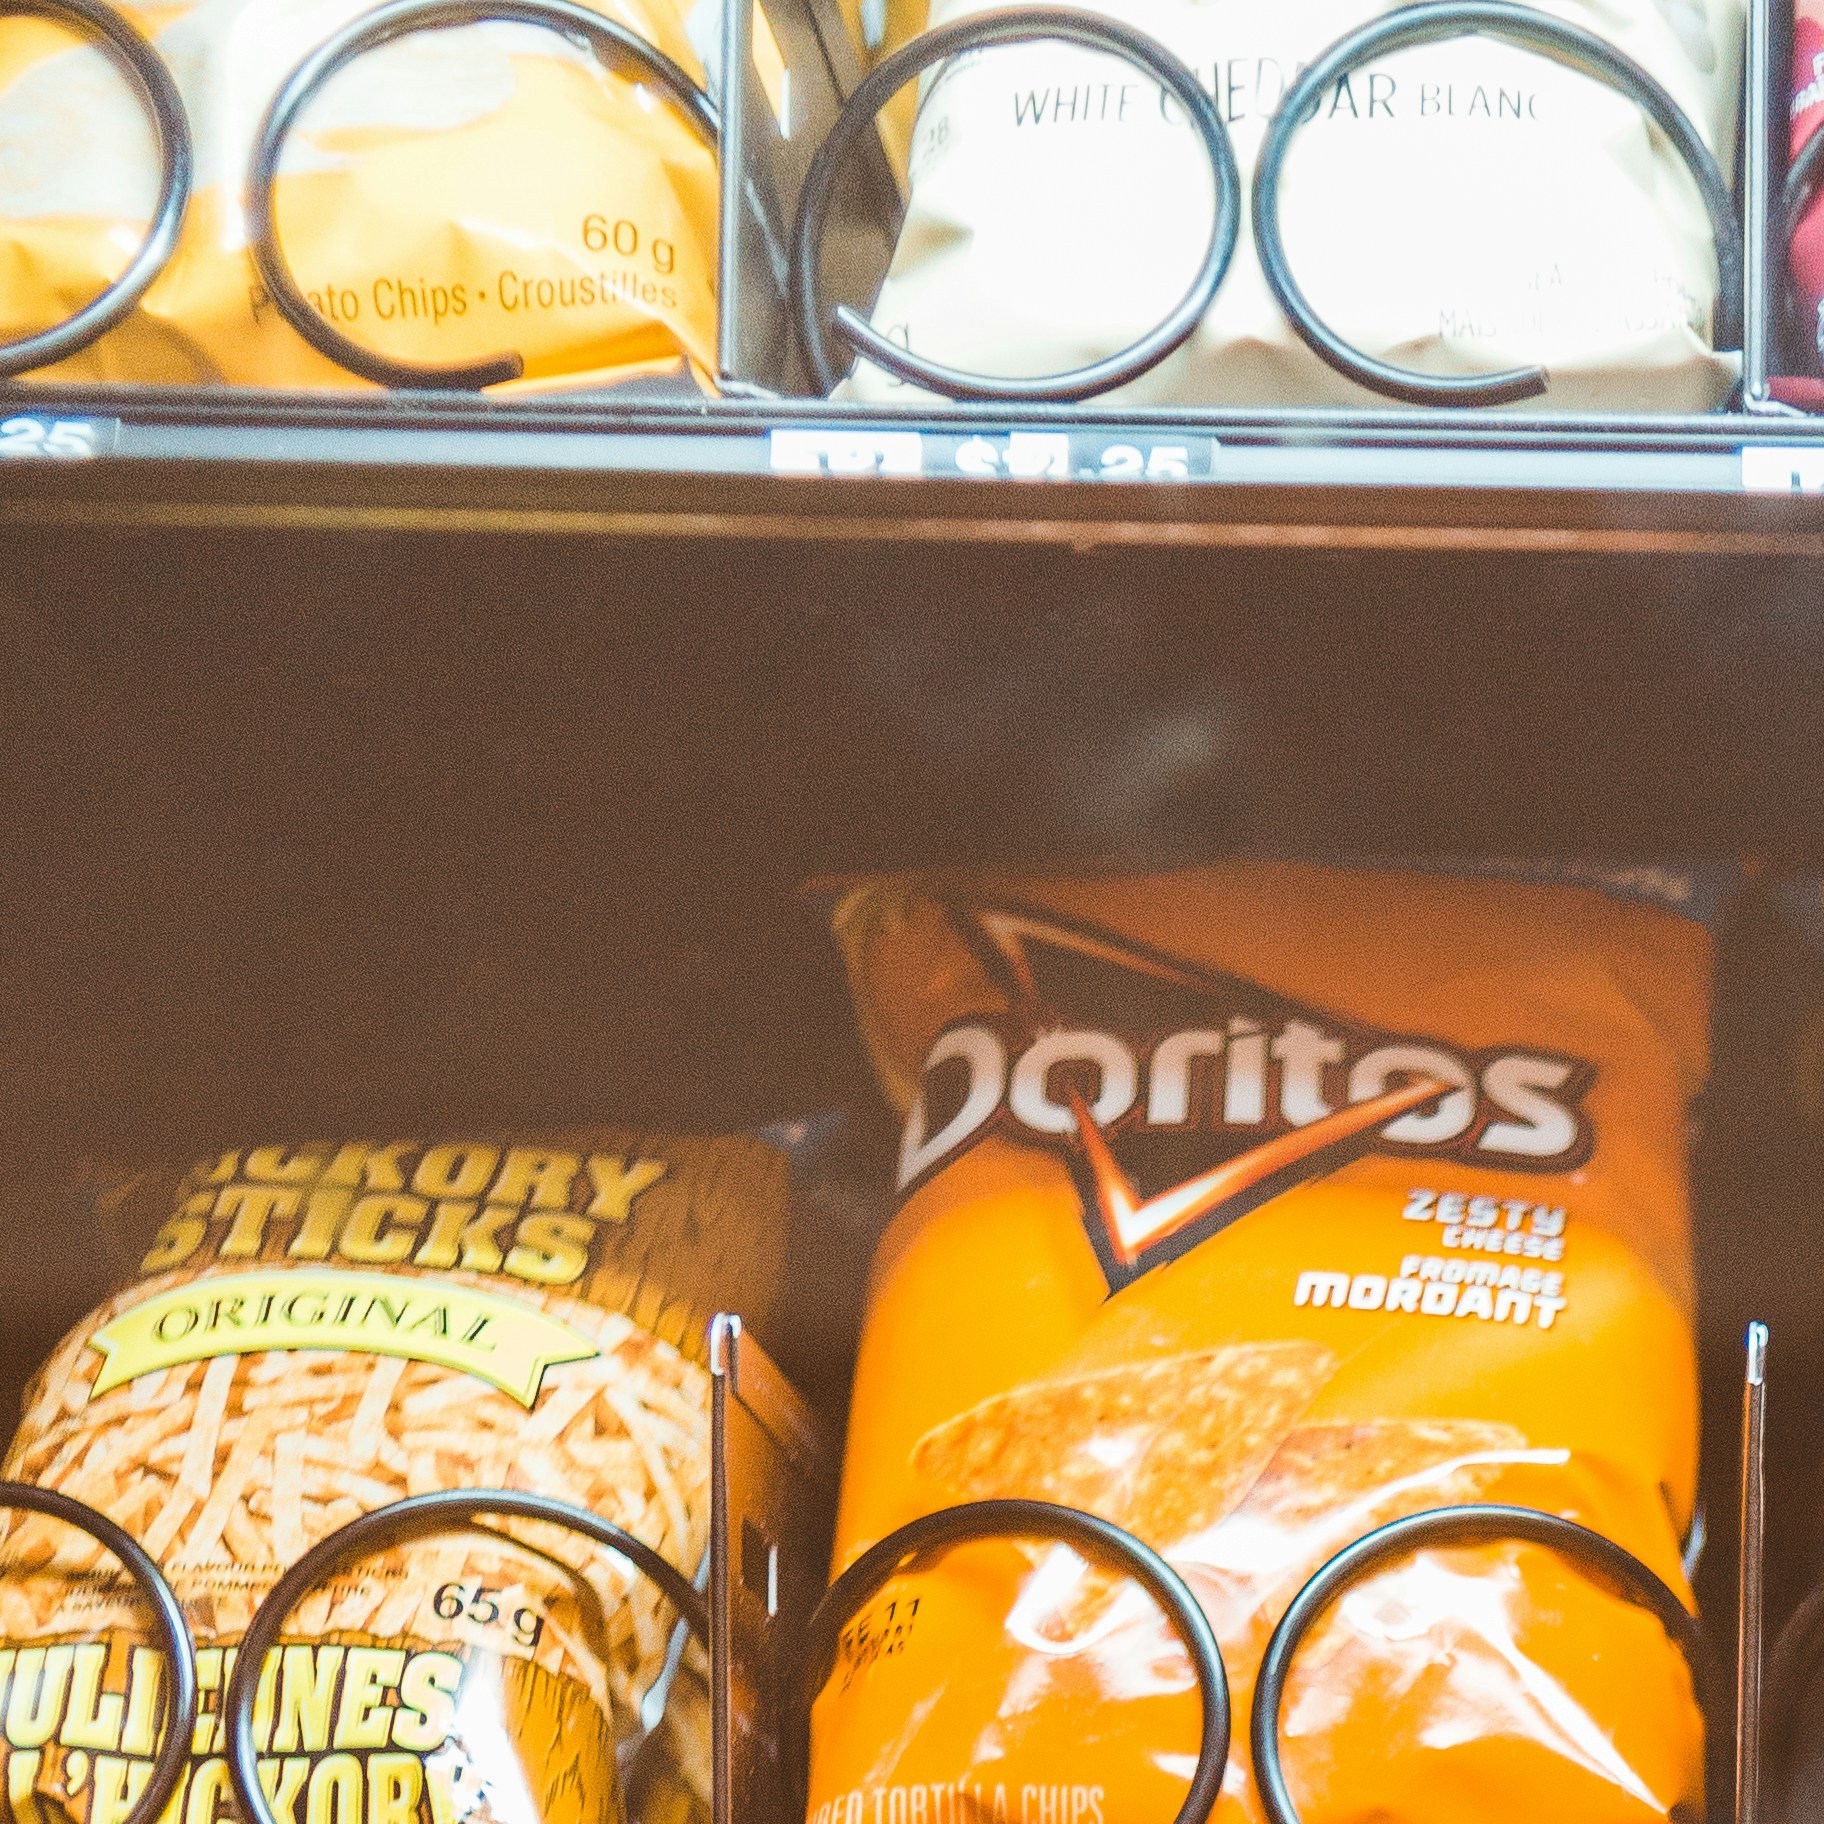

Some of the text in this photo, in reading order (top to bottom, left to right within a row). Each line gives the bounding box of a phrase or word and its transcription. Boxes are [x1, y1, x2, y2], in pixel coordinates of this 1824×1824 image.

[1014, 82, 1141, 127] WHITE
[582, 214, 676, 274] 60 g
[373, 268, 679, 322] Chips Croustilles
[897, 1018, 1578, 1194] Doritos
[142, 1186, 597, 1284] STICKS
[1404, 1189, 1566, 1238] ZESTY
[1442, 1224, 1563, 1262] CHEESE
[1295, 1270, 1566, 1329] MORDANT
[1400, 1255, 1563, 1298] FROMAGE
[151, 1288, 499, 1353] ORIGINAL
[432, 1582, 499, 1625] 65
[514, 1605, 546, 1648] g
